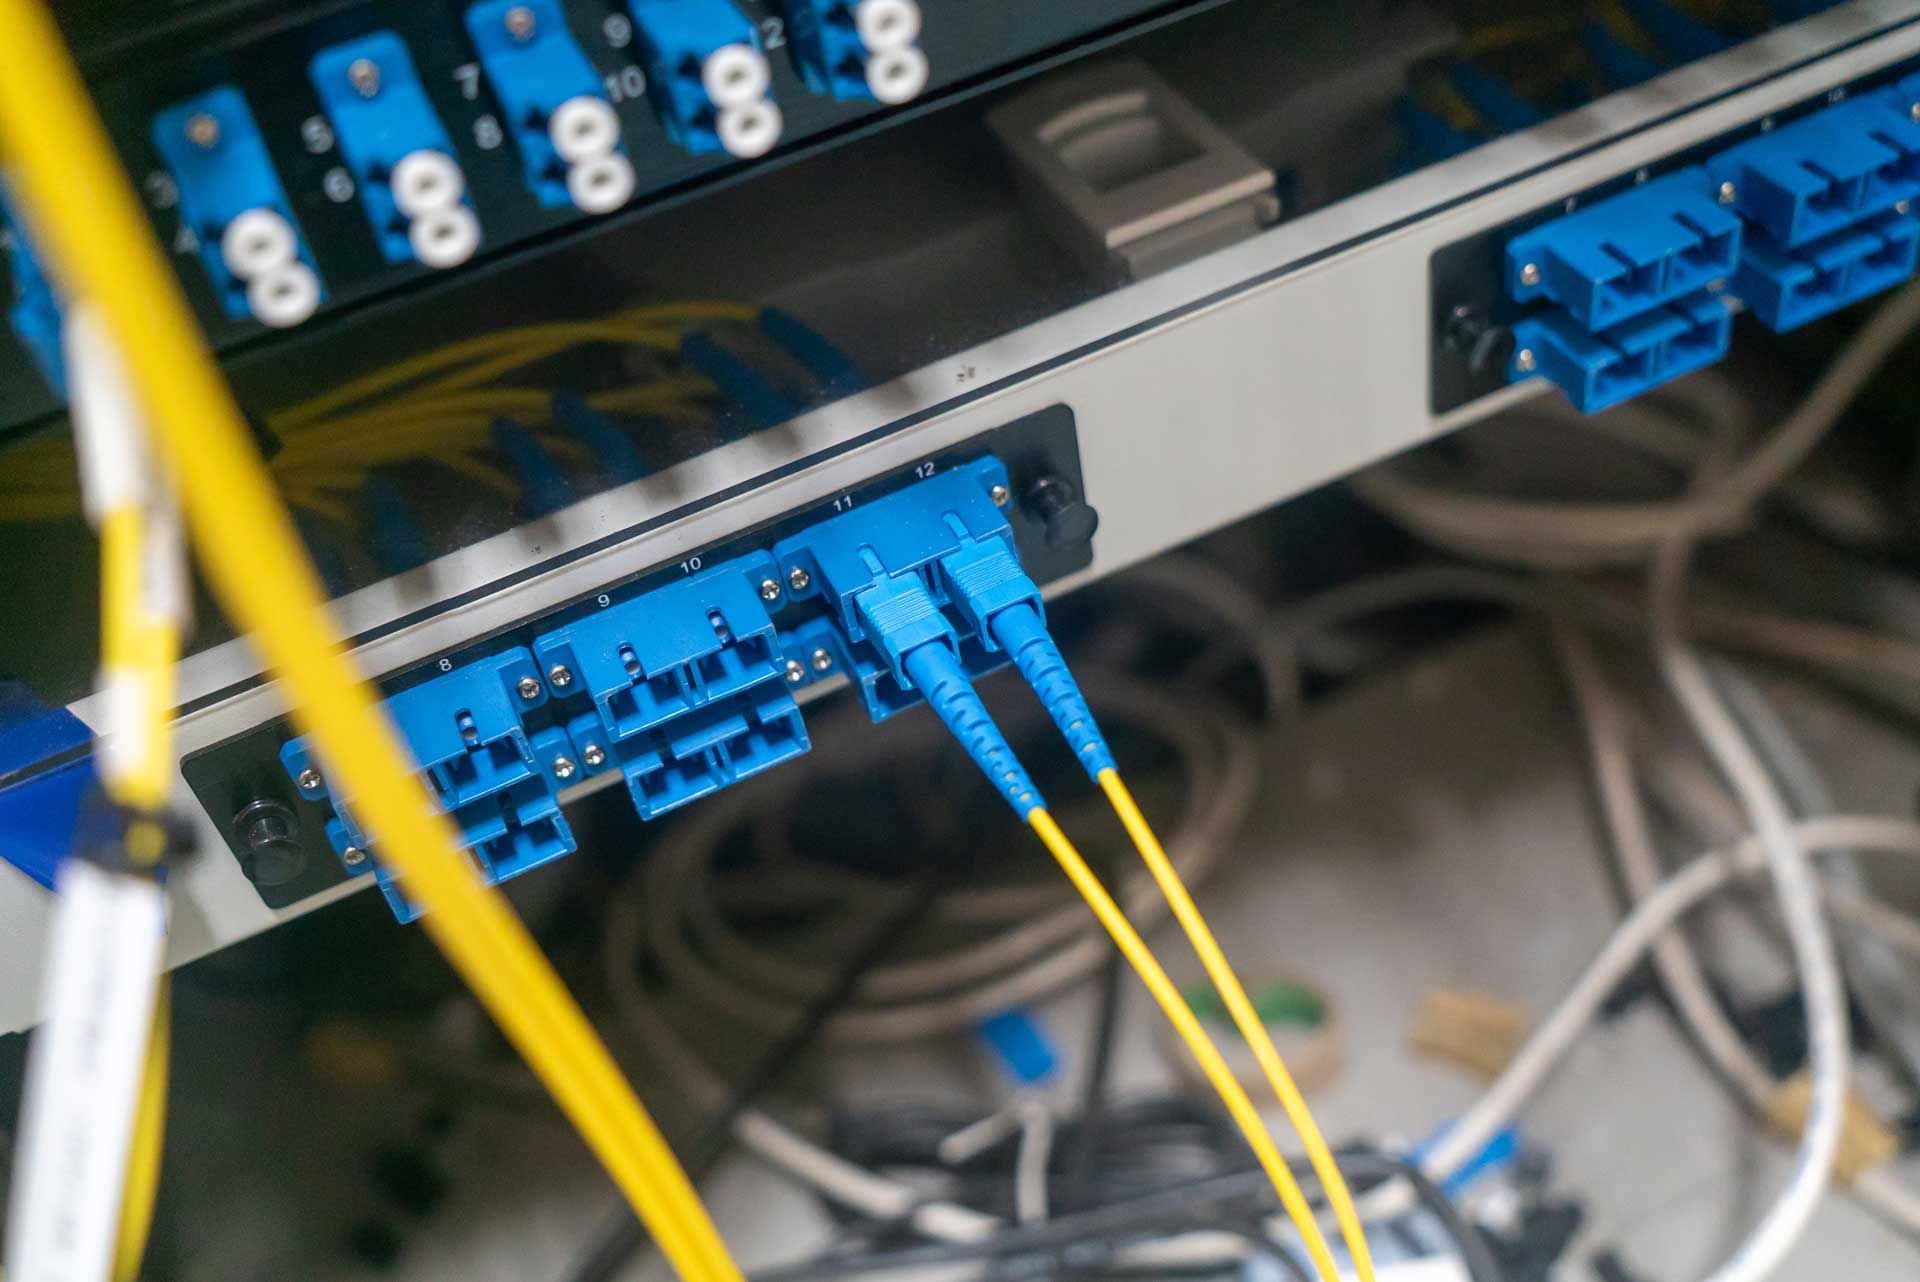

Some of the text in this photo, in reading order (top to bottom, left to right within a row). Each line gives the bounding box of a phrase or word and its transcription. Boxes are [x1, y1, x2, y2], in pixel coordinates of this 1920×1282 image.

[602, 13, 633, 48] 9
[453, 62, 481, 101] 7
[605, 65, 646, 104] 10
[473, 114, 504, 150] 8
[323, 167, 355, 204] 6
[915, 461, 936, 480] 12
[833, 495, 854, 512] 11
[680, 557, 702, 574] 10
[597, 594, 611, 608] 9
[438, 657, 453, 672] 8
